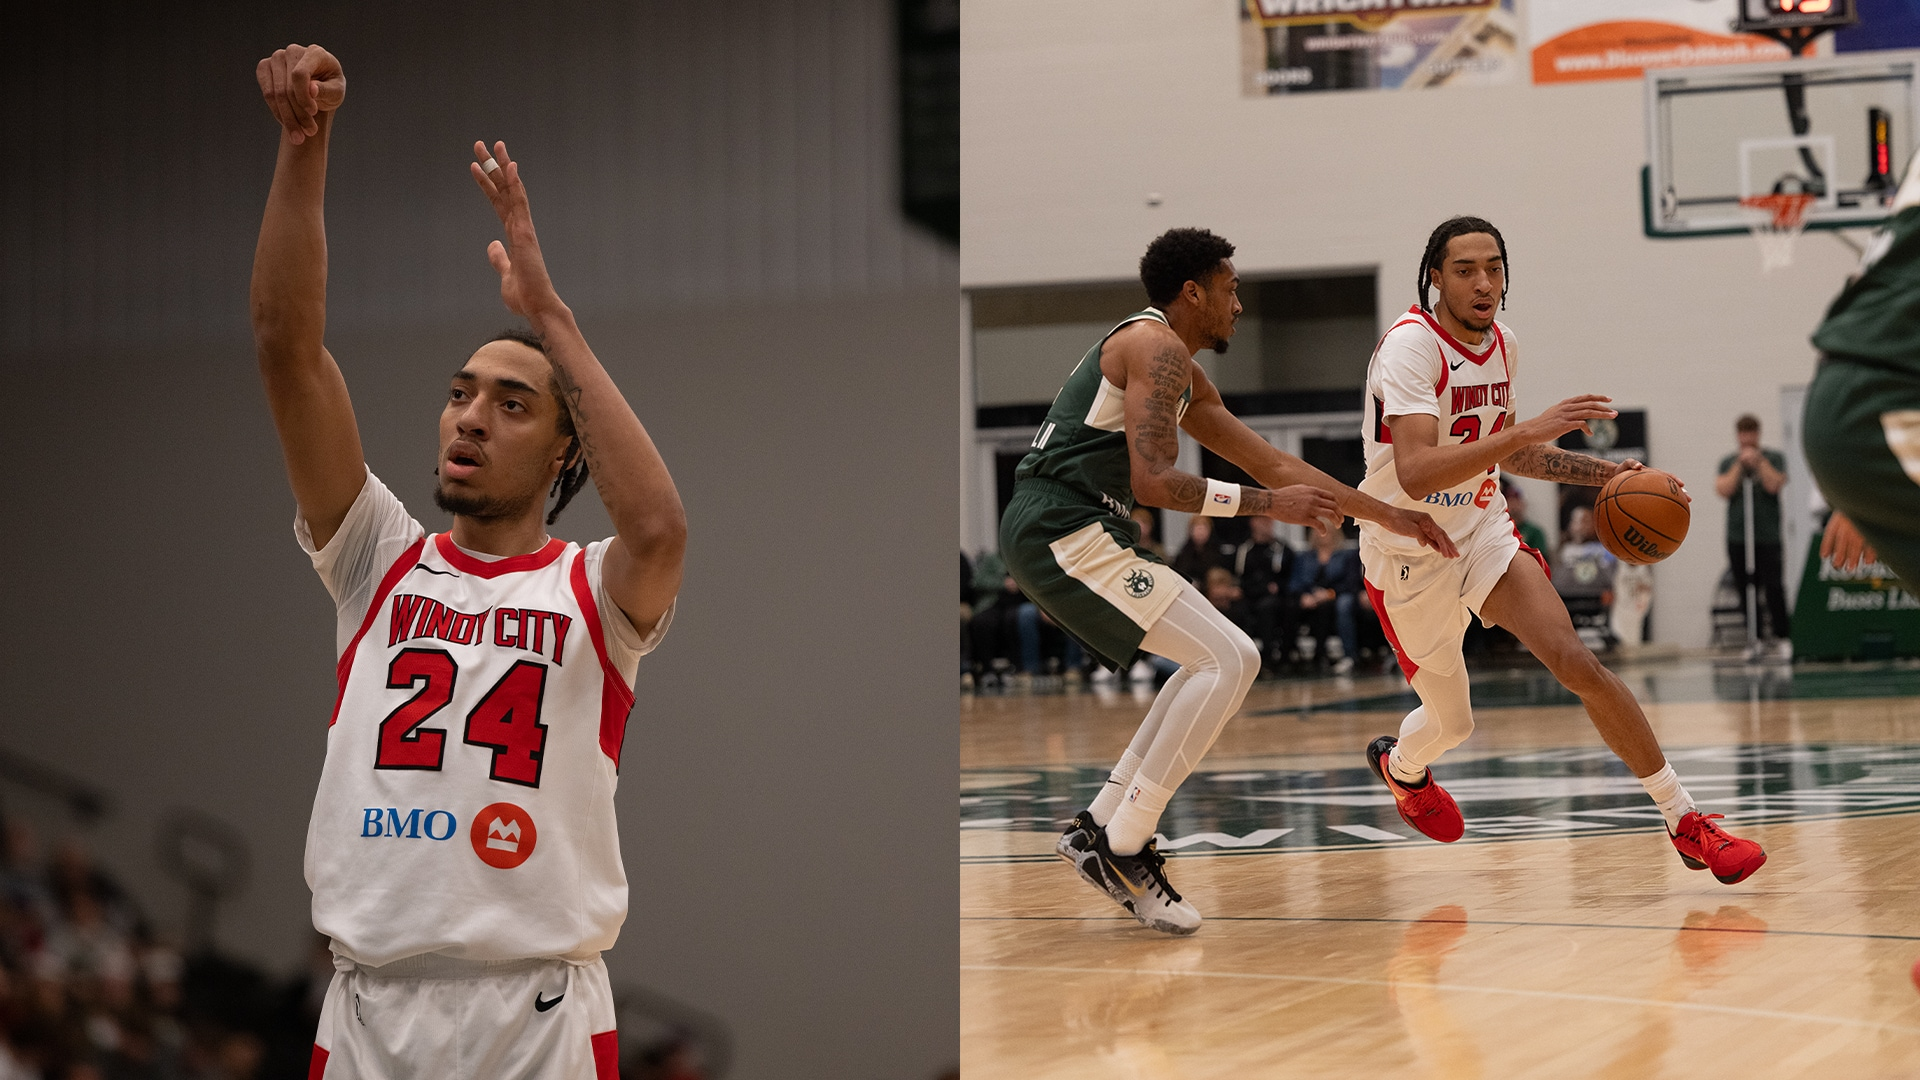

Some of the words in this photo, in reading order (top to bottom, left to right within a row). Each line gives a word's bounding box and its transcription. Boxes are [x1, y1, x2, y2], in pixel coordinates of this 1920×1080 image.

[1451, 384, 1489, 415] WINDY
[1423, 491, 1473, 507] BMO
[387, 593, 494, 648] WINDY
[494, 607, 572, 667] CITY
[374, 648, 549, 789] 24
[361, 808, 457, 841] BMO
